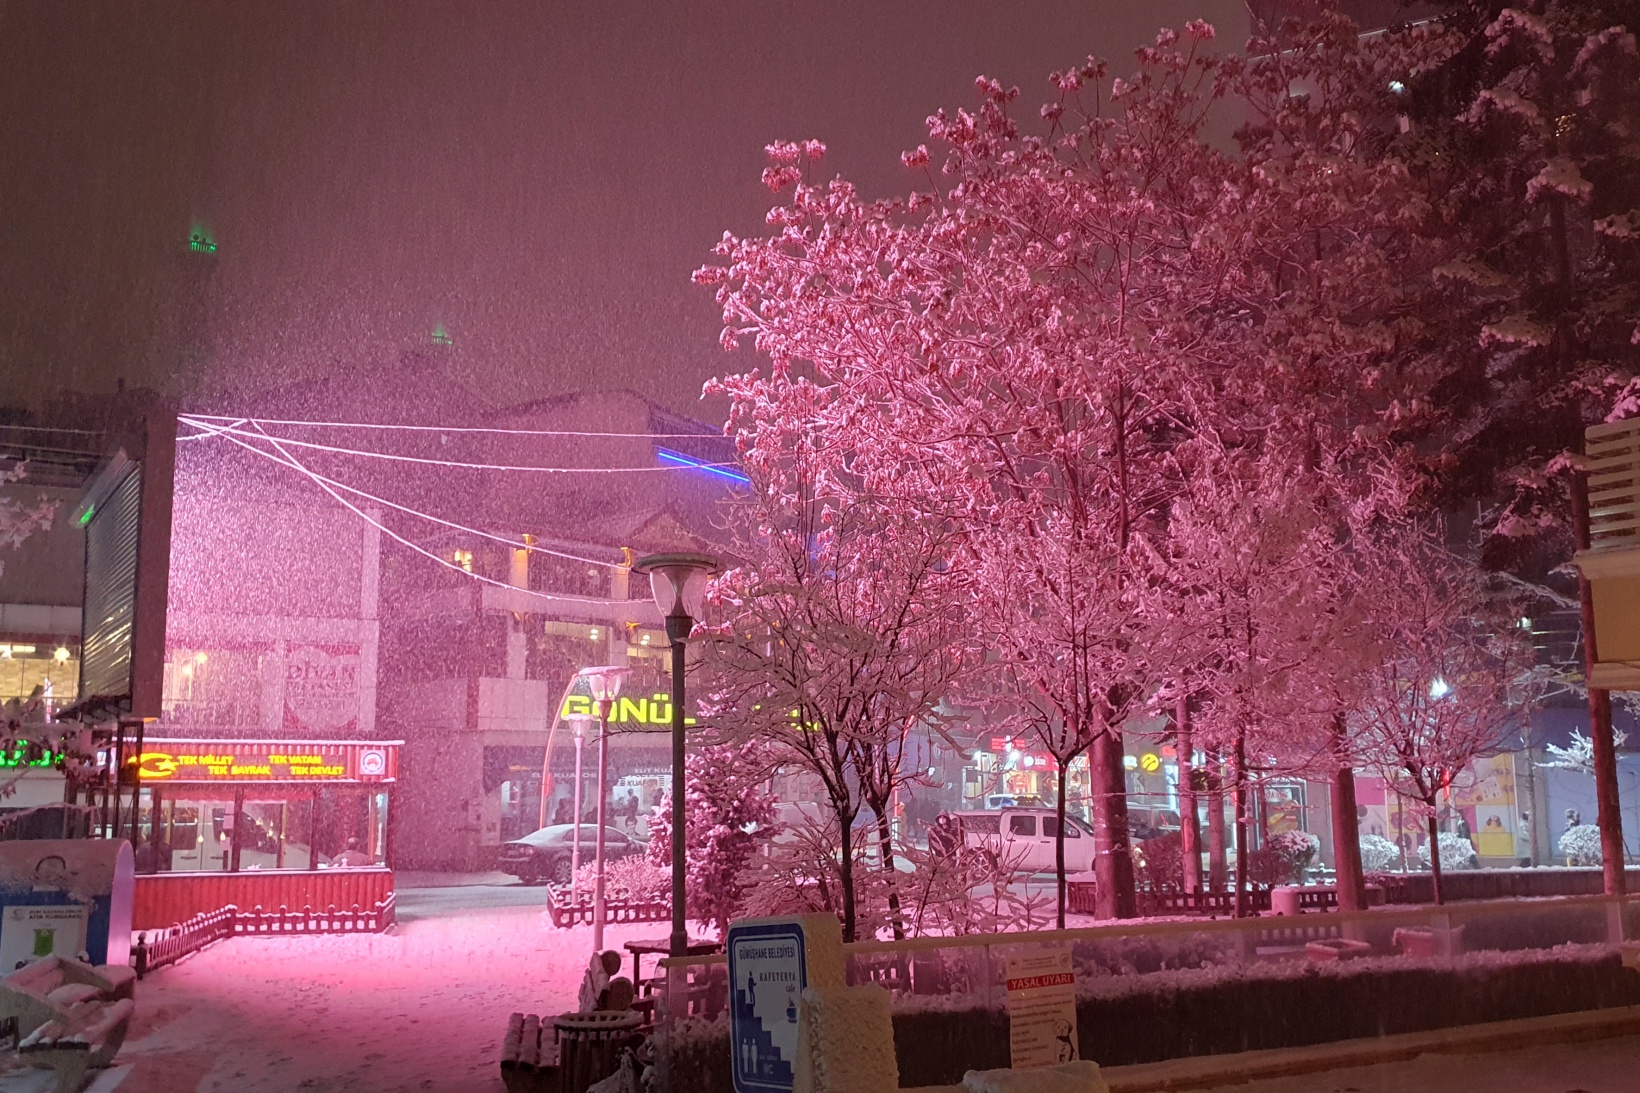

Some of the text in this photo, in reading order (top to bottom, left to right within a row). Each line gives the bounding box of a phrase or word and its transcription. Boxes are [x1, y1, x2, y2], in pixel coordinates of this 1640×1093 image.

[561, 693, 696, 724] GÖNÜ
[178, 754, 233, 765] TEK MİLLET
[268, 755, 321, 764] TEK VATAN
[208, 765, 270, 775] TEK BAYRAK
[290, 766, 344, 775] TEK DEVLET
[1012, 974, 1070, 989] YASAL UYARI
